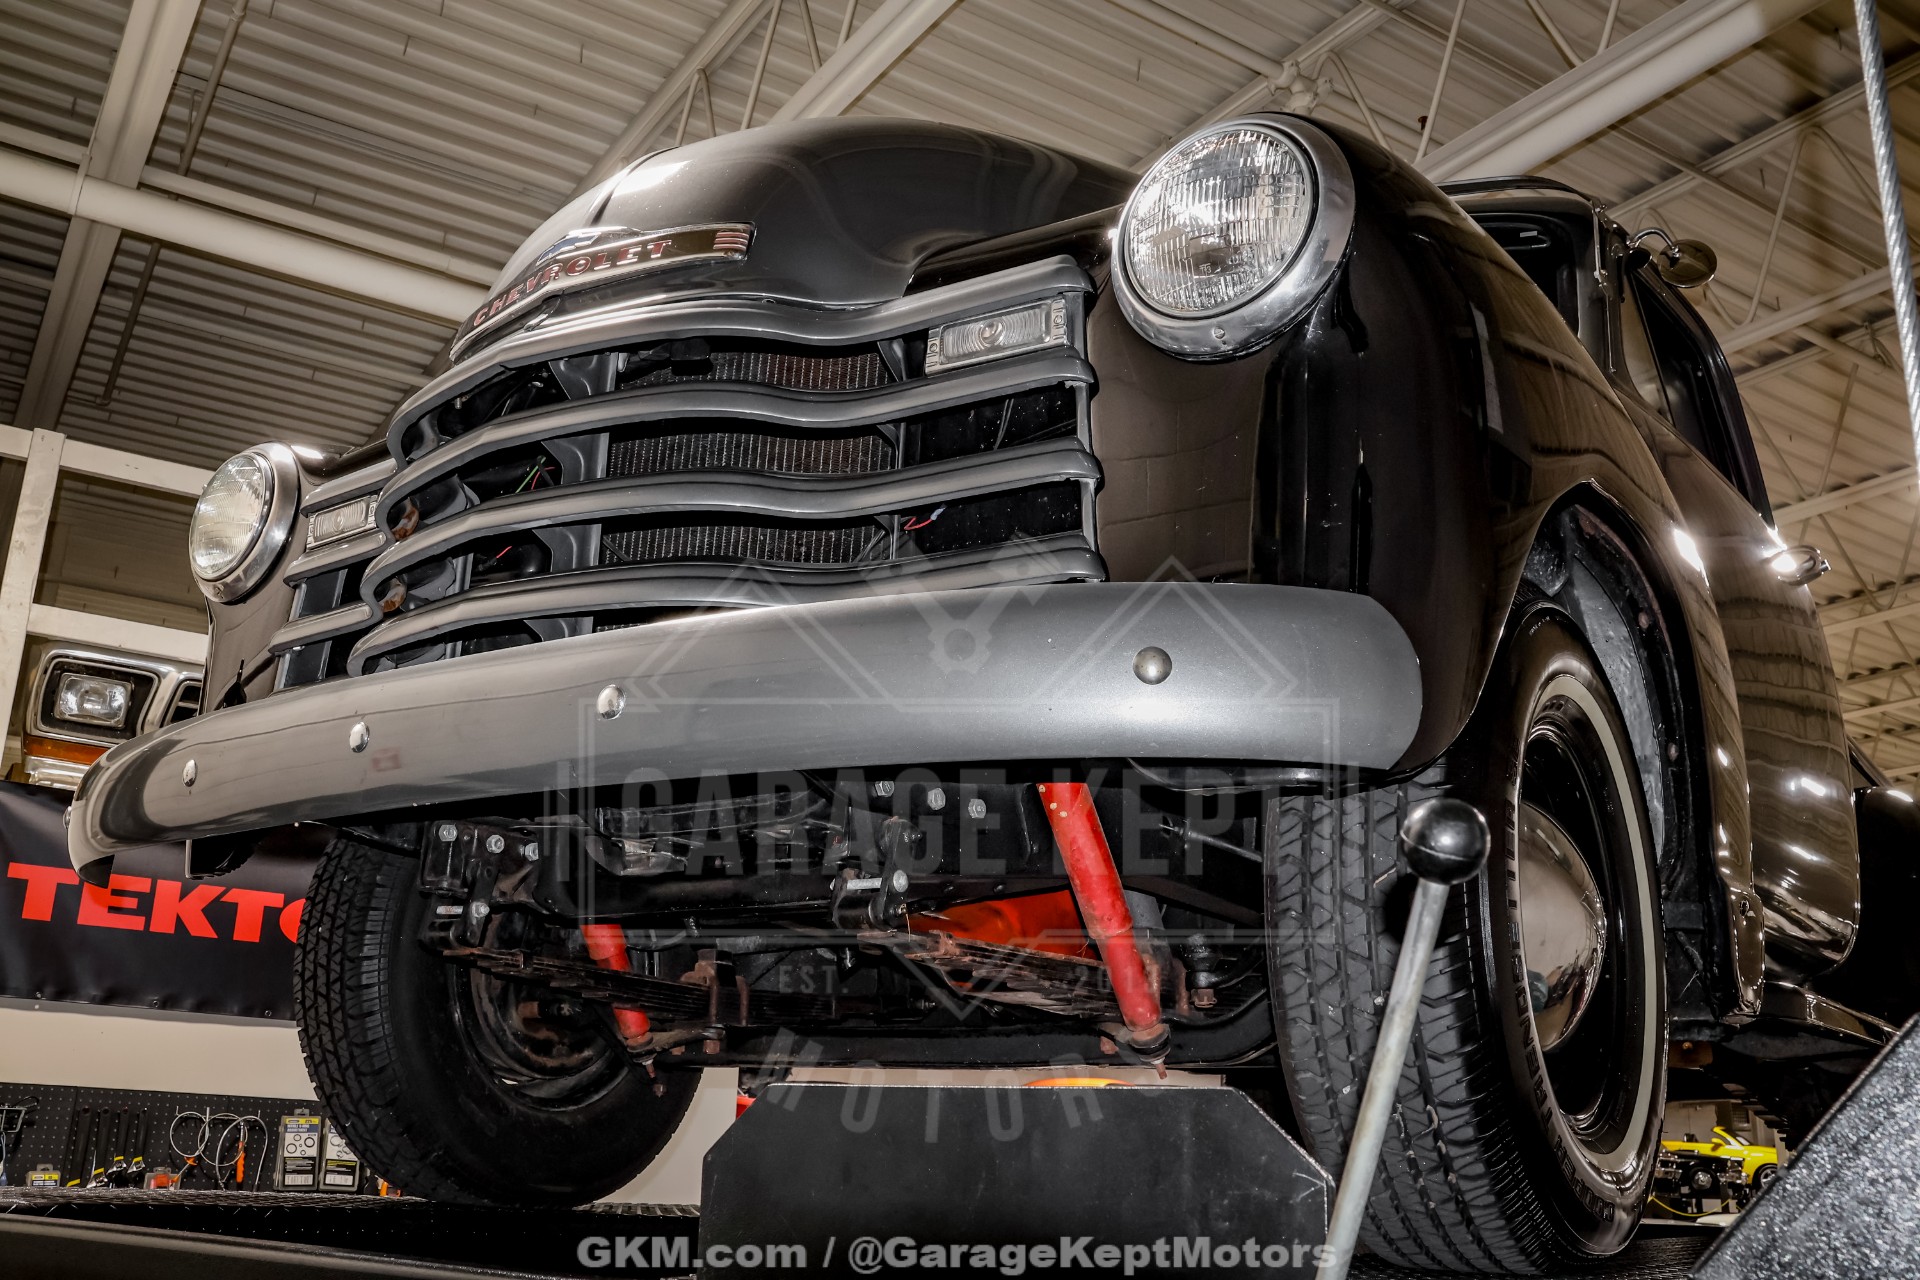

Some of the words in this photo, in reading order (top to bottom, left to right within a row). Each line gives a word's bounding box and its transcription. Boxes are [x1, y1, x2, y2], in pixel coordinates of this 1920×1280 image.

[473, 239, 672, 326] CHEVROLET
[1503, 798, 1553, 1136] TRENDSETTER
[1554, 1136, 1615, 1223] COOPER
